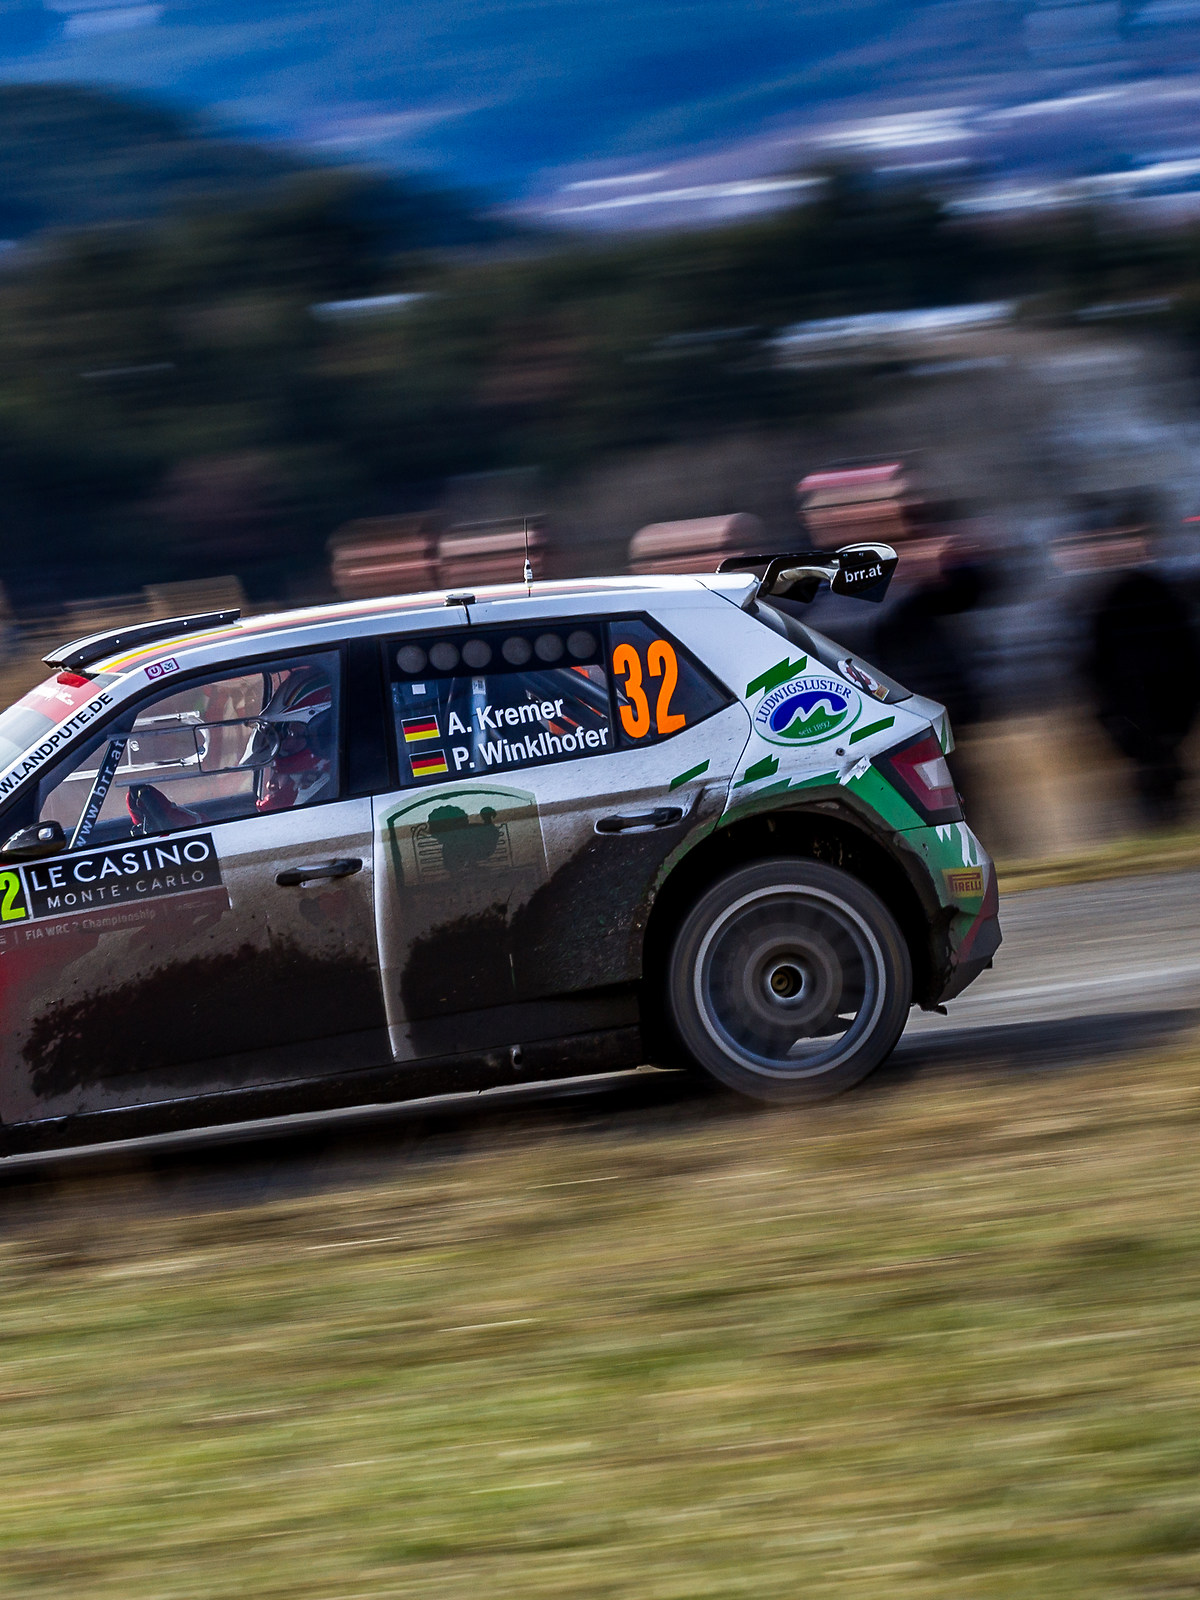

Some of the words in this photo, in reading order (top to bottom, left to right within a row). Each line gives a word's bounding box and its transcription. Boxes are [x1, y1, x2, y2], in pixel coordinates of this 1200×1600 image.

[845, 564, 882, 583] brr.at
[613, 640, 686, 738] 32
[756, 680, 852, 724] LUDWIGSLUSTER
[448, 712, 473, 735] A.
[477, 698, 564, 730] Kremer
[452, 747, 475, 770] P.
[478, 726, 609, 765] Winklhofer
[30, 866, 67, 892] LE
[73, 840, 210, 882] CASINO
[947, 872, 982, 893] PIRELLI
[25, 929, 44, 940] FIA
[45, 923, 70, 936] WRC
[82, 908, 157, 929] Championship
